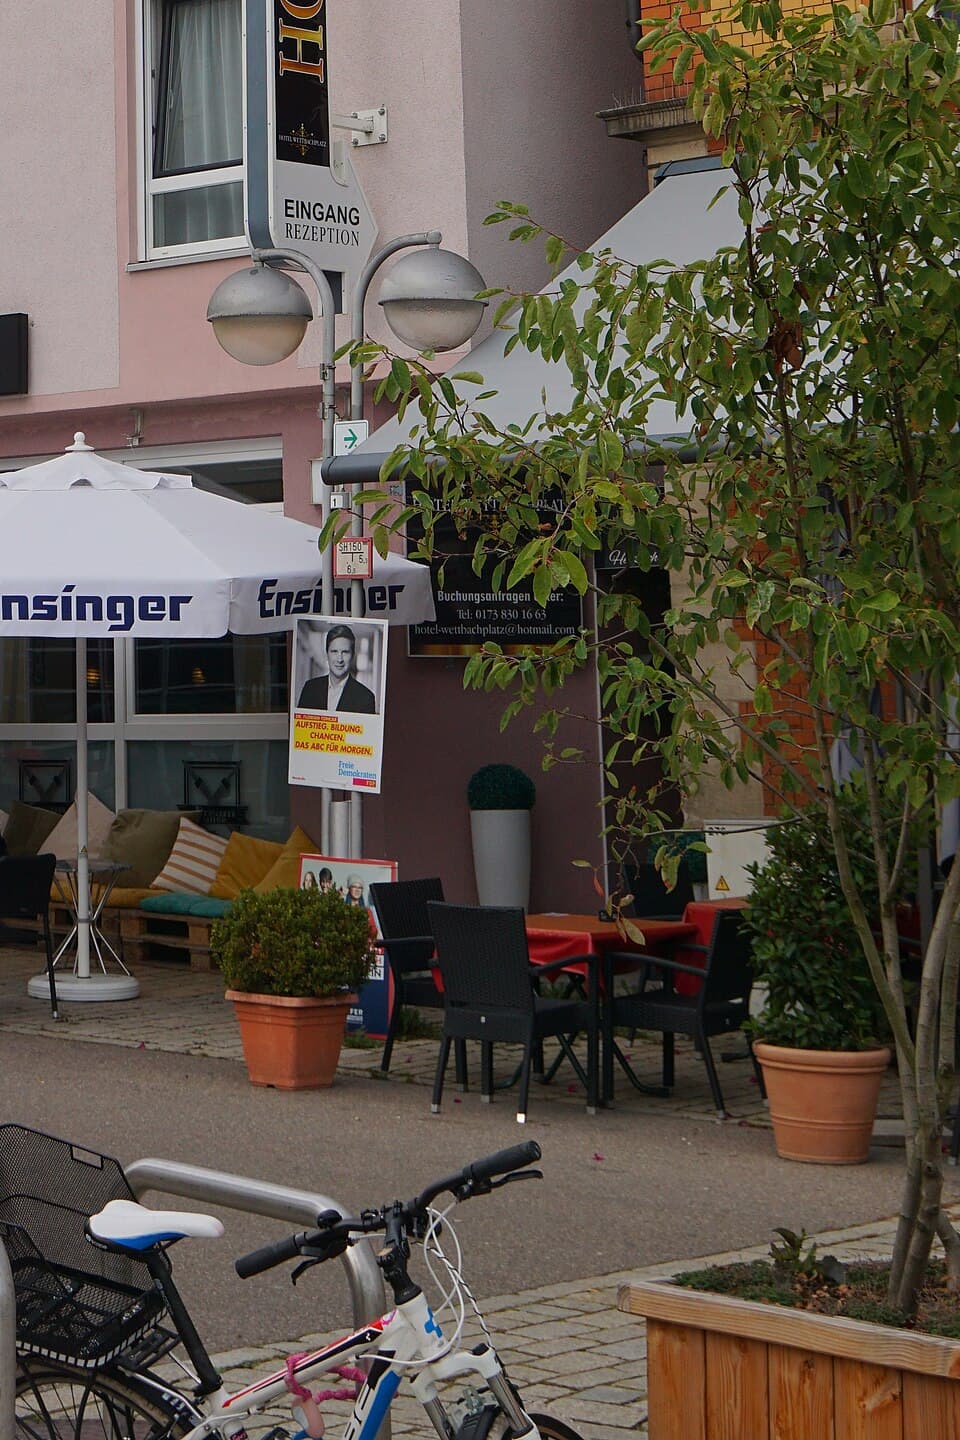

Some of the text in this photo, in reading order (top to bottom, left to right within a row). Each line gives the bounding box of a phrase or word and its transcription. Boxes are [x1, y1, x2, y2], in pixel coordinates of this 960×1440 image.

[284, 198, 360, 226] EINGANG
[285, 222, 360, 247] REZEPTION
[437, 590, 531, 604] Buchungsanfragen
[456, 609, 547, 620] Tel: 0173 830 16 63
[414, 623, 576, 637] hotel-wettbachplatz@hotmail.com
[295, 720, 363, 734] AUFSTIEG. BILDUNG.
[310, 731, 345, 742] CHANCEN.
[295, 741, 372, 755] DAS ABC FÜR MORGEN.
[339, 760, 355, 769] Freie
[338, 769, 377, 779] Demokraten
